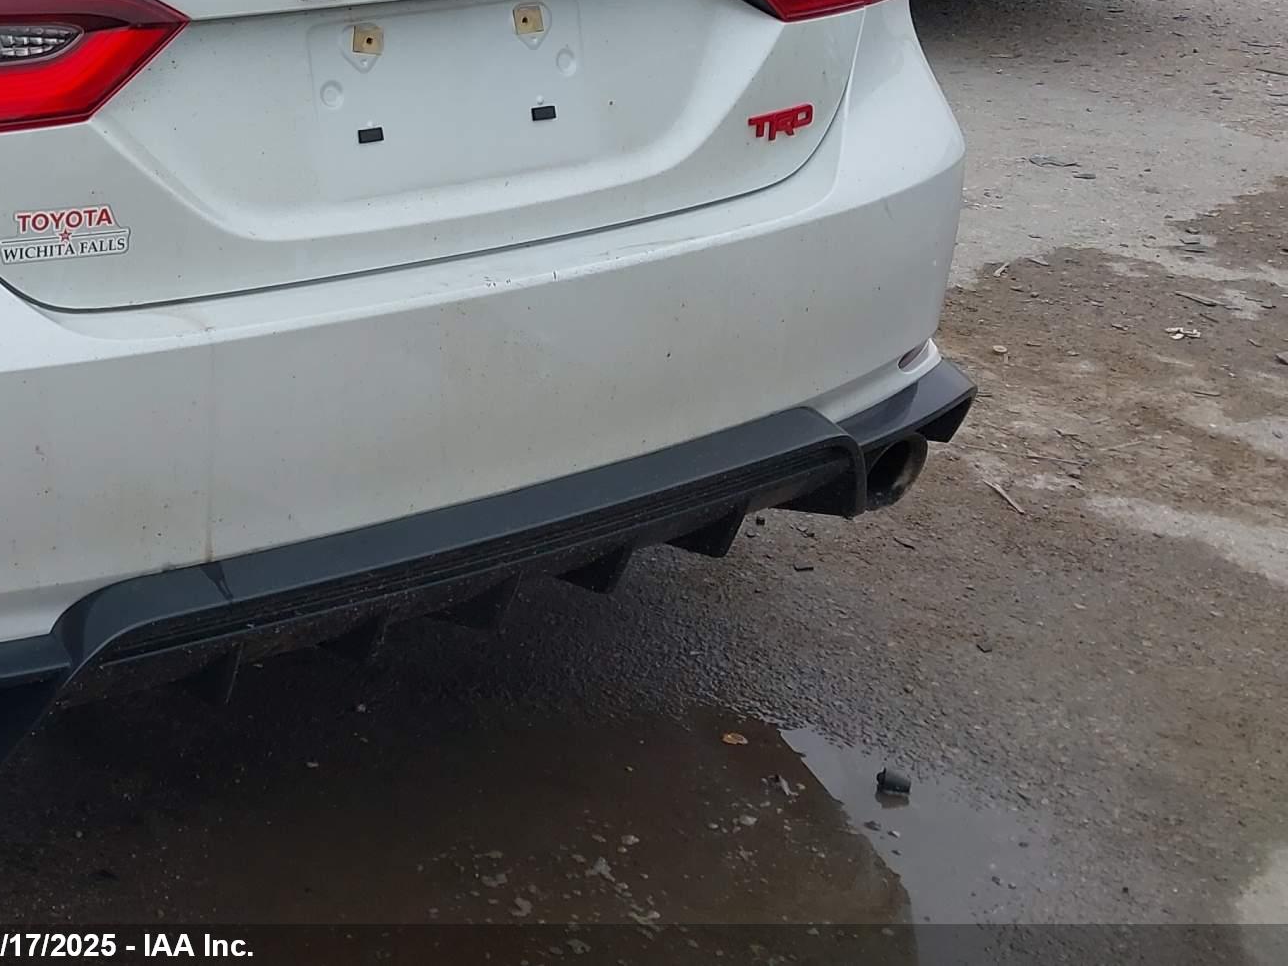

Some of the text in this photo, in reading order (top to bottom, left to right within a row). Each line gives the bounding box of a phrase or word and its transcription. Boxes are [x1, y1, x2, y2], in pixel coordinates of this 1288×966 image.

[748, 104, 813, 141] TRD
[17, 208, 112, 232] TOYOTA
[3, 237, 125, 262] WICHITA FALLS
